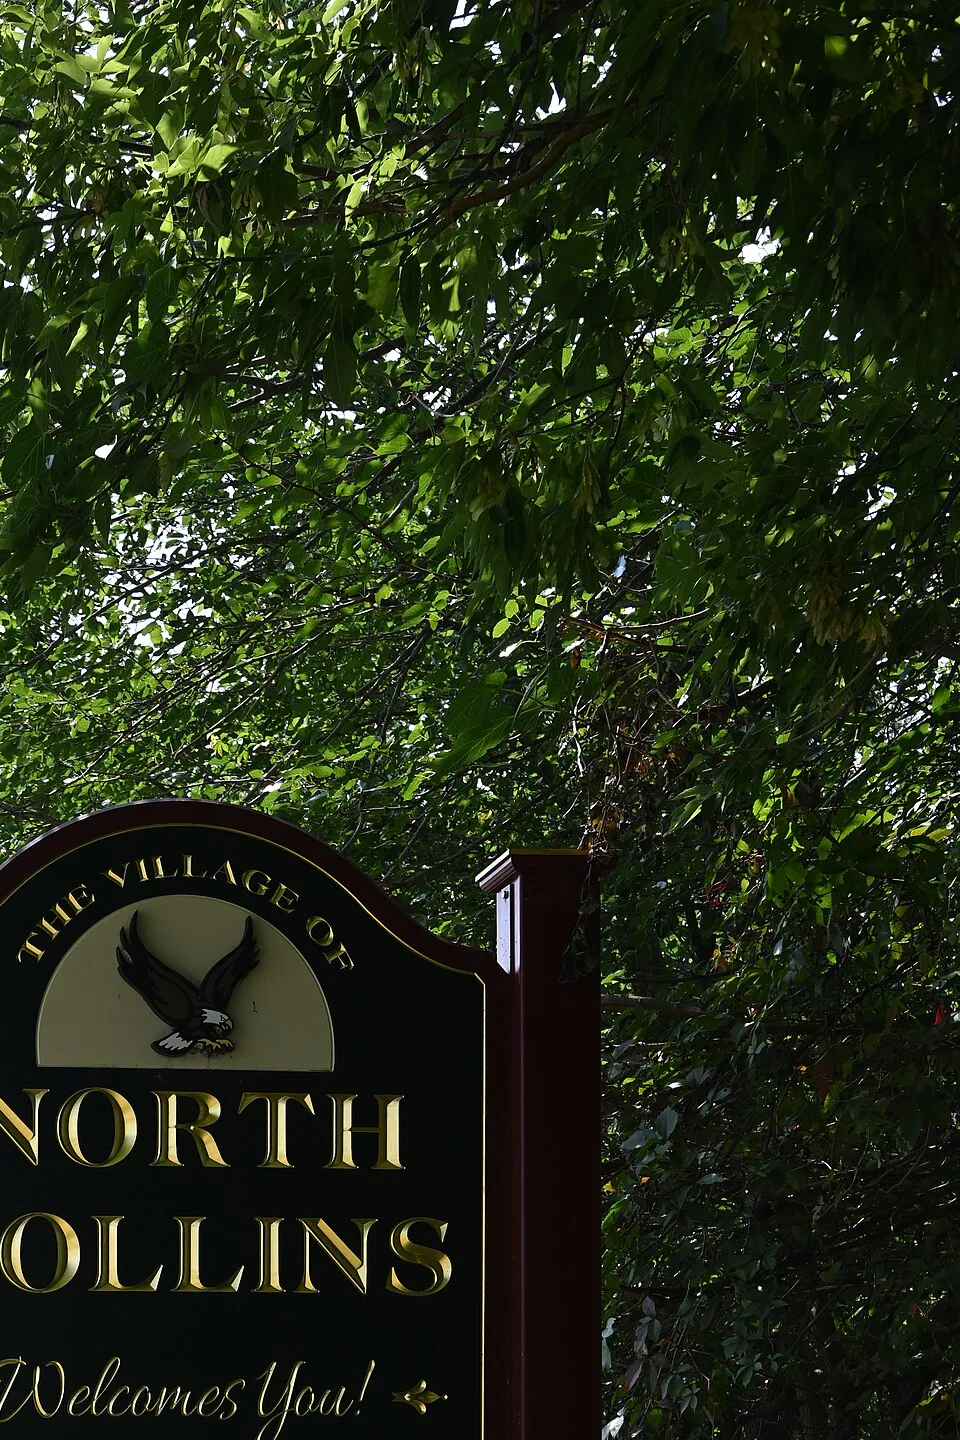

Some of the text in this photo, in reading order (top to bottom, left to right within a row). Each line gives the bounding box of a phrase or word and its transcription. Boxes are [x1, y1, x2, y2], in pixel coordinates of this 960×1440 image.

[15, 854, 356, 971] THE VILLAGE OF
